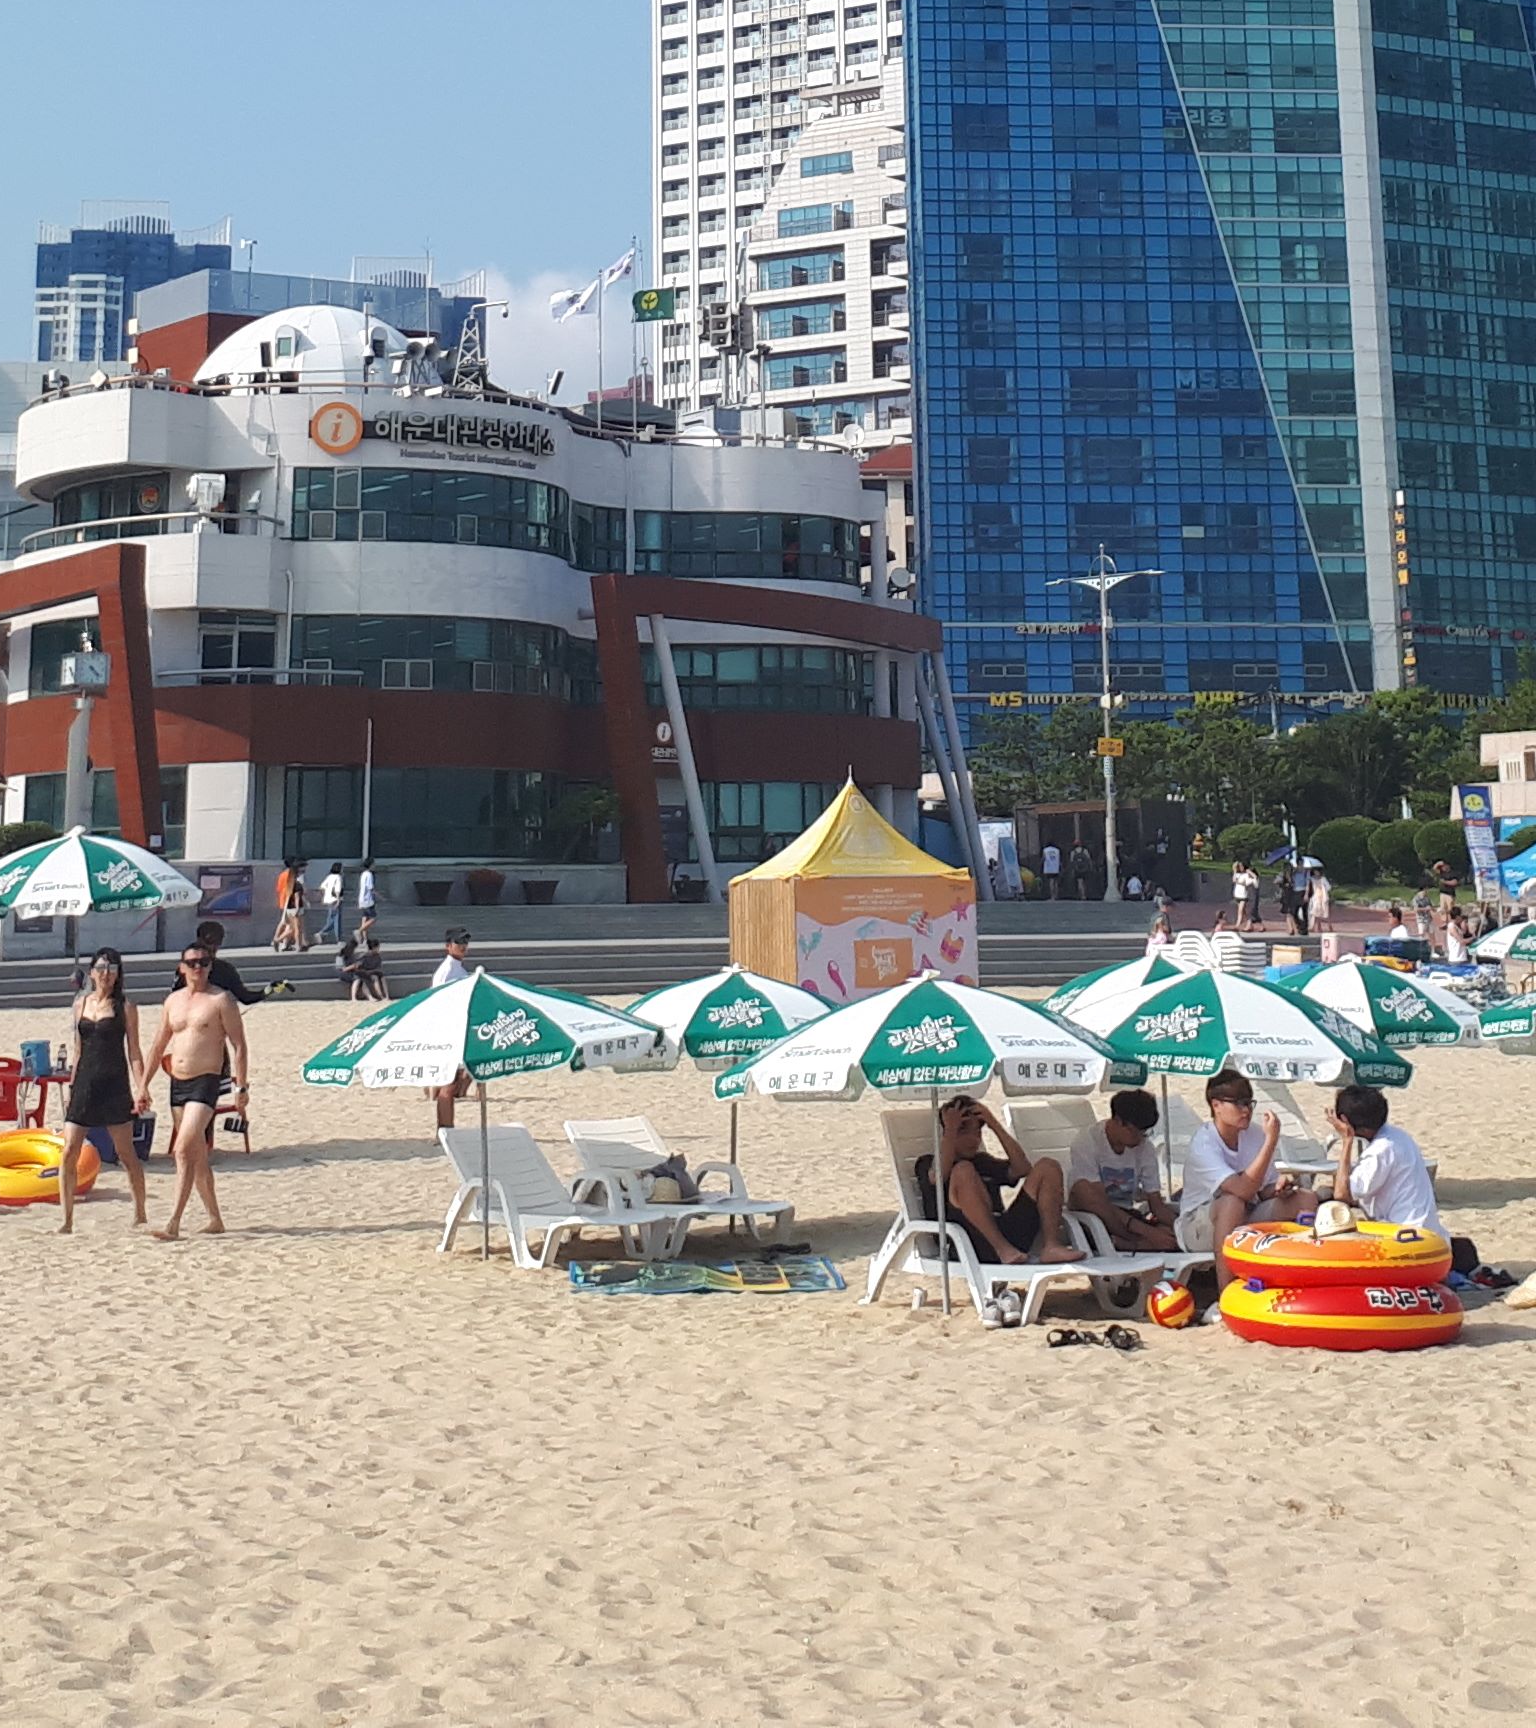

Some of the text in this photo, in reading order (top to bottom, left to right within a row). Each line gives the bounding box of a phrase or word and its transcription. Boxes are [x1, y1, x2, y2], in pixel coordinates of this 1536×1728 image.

[375, 411, 557, 458] 해운대관광안내소
[990, 691, 1023, 708] MS
[522, 1032, 541, 1047] 5.0
[876, 1069, 912, 1084] 세상에
[913, 1066, 936, 1082] 없던
